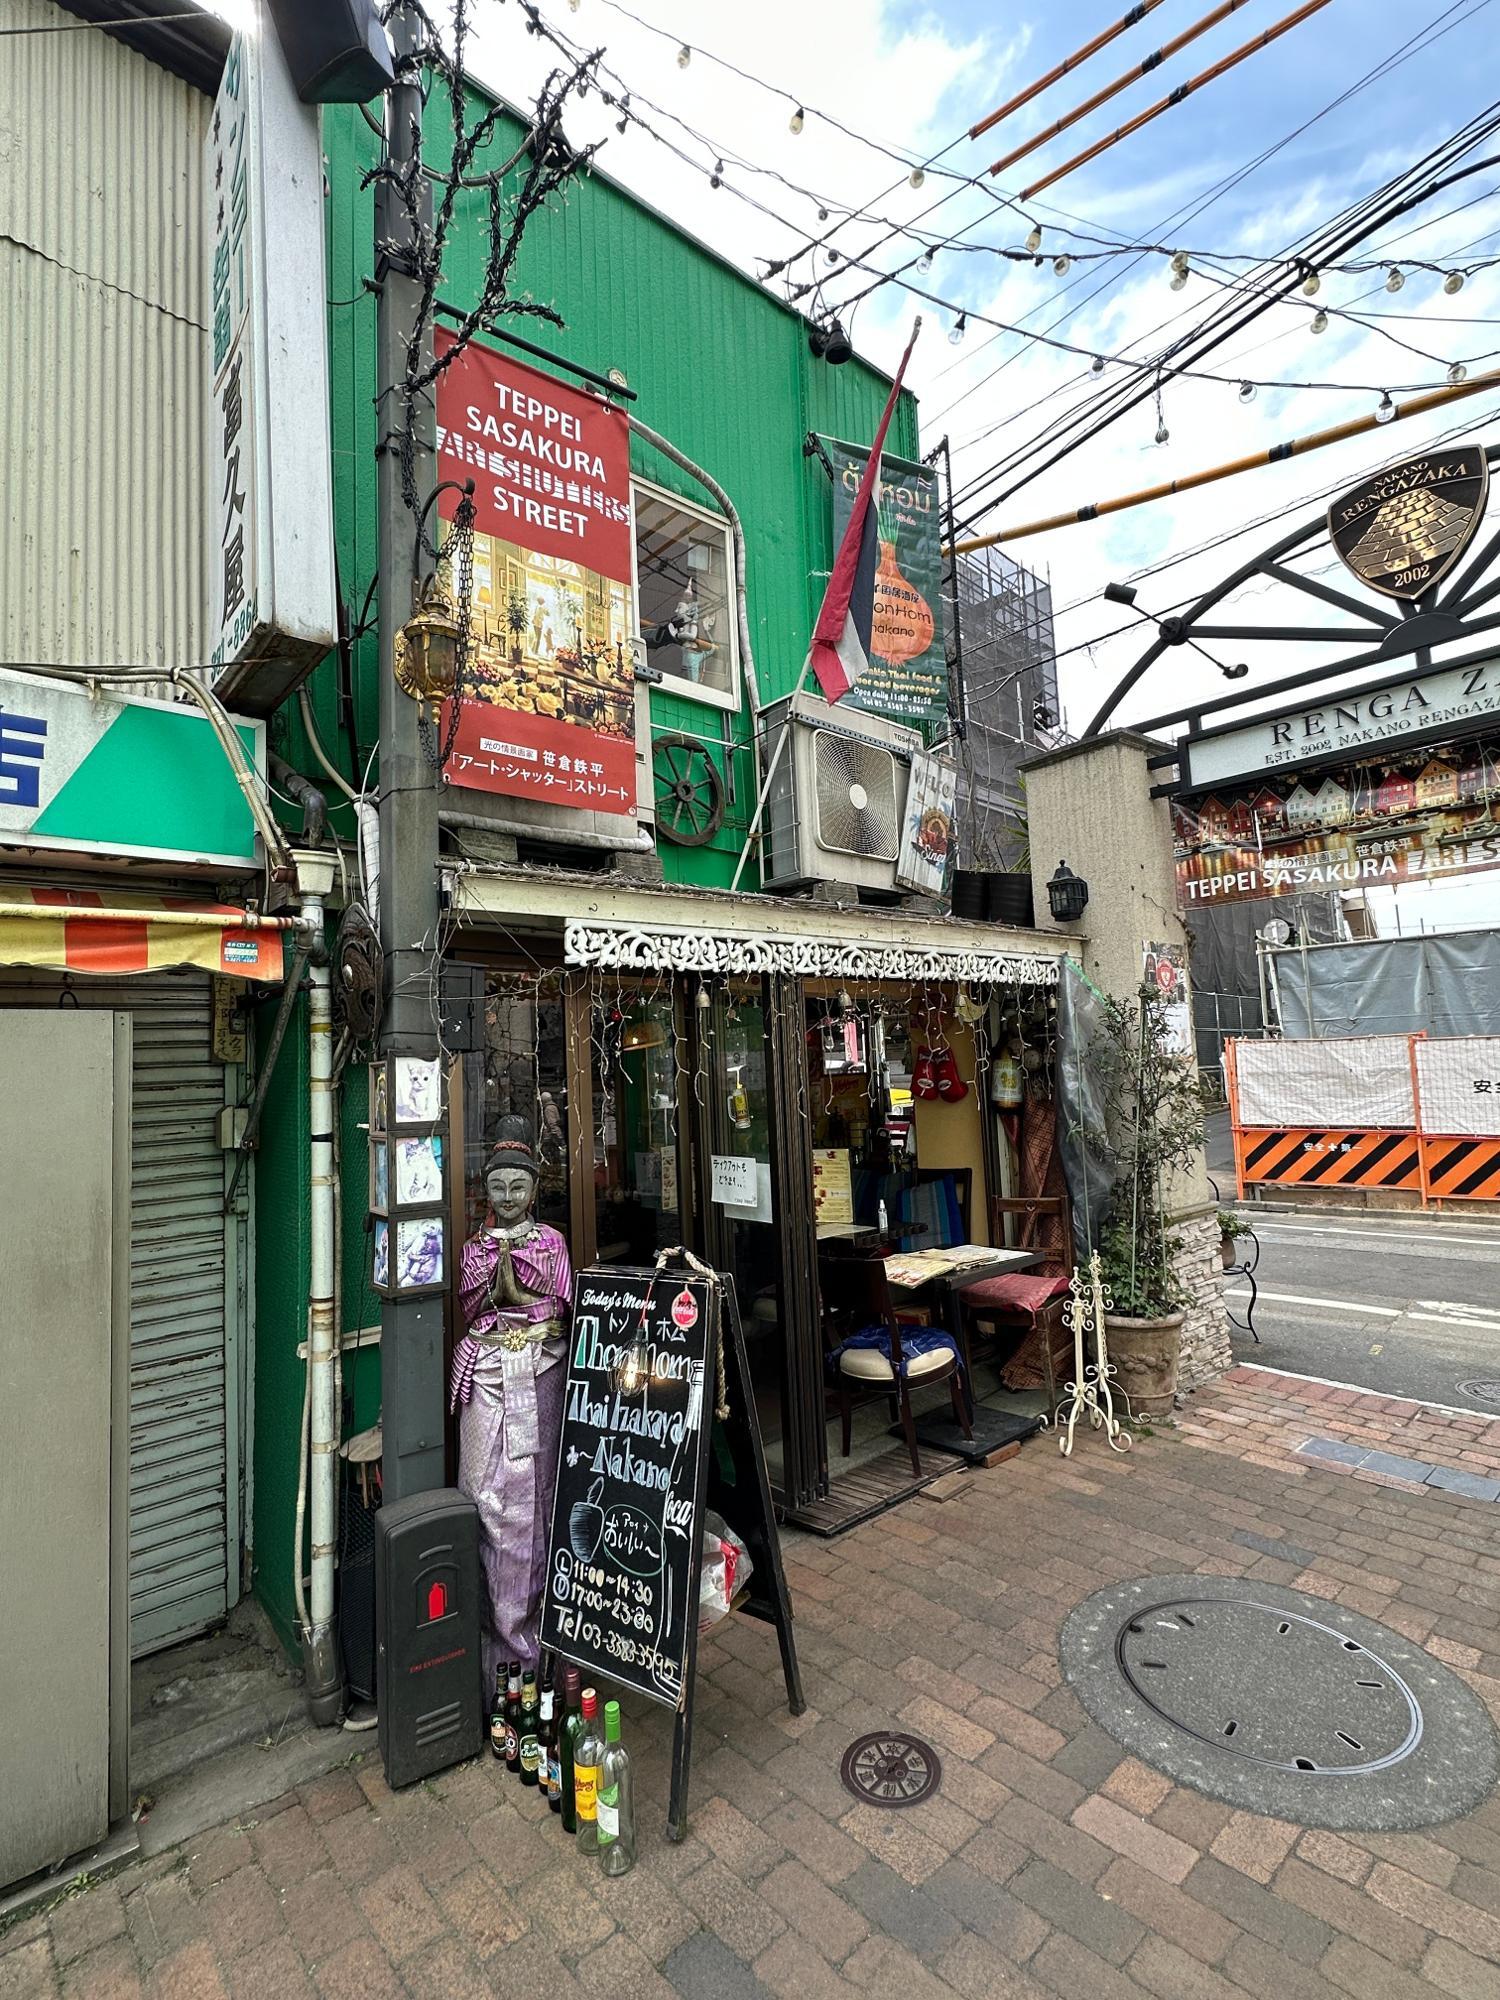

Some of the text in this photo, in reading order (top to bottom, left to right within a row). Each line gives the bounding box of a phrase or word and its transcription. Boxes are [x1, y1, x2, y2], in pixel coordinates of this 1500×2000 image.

[493, 381, 582, 442] TEPPEI
[466, 405, 607, 484] SASAKURA
[222, 350, 246, 632] 富久屋
[1340, 463, 1468, 523] RENGAZAKA
[1374, 461, 1429, 490] NAKANO
[493, 486, 589, 538] STREET
[1394, 564, 1431, 588] 2002
[874, 602, 931, 625] onHom
[853, 686, 872, 697] Open
[888, 669, 910, 680] Thai
[1270, 667, 1500, 746] RENGA Z
[483, 740, 604, 778] 光の情景画家 笹倉鉄平
[894, 732, 919, 748] TOSHIBA
[1265, 749, 1297, 764] EST.
[1301, 740, 1332, 756] 2002
[1339, 719, 1411, 744] NAKANO
[1186, 871, 1256, 899] TEPPEI
[1262, 854, 1398, 887] SASAKURA
[582, 1289, 622, 1312] Today's
[622, 1292, 656, 1310] Menu
[568, 1379, 684, 1448] Thai Izakaya
[552, 1604, 583, 1642] Tel
